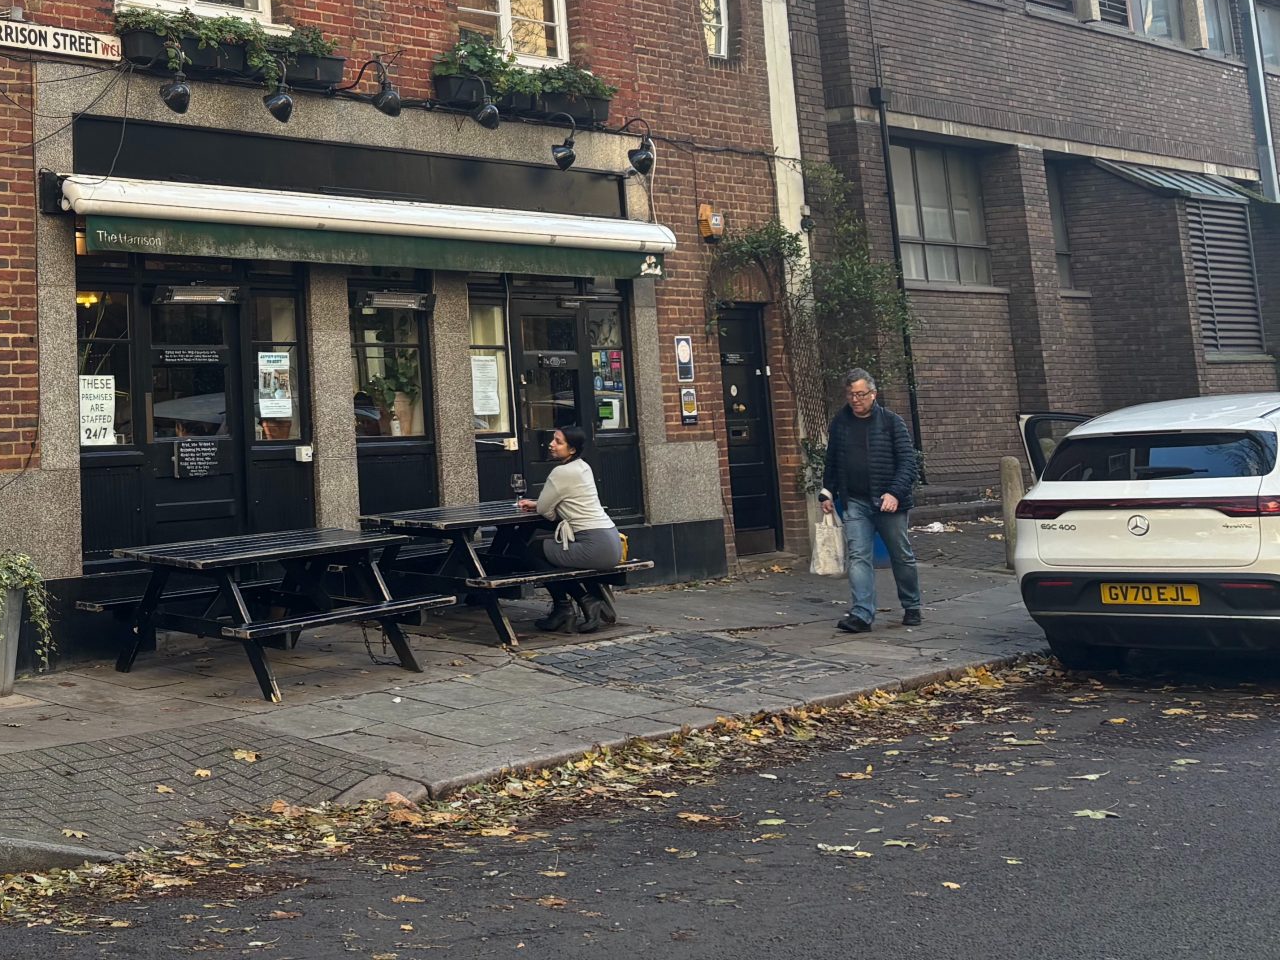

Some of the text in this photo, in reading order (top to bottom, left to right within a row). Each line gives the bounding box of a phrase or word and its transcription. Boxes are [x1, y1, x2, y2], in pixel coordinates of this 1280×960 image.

[53, 31, 100, 55] STREET
[96, 230, 162, 246] The Harrison
[81, 378, 112, 390] THESE
[81, 393, 113, 401] PREMISES
[90, 403, 105, 412] ARE
[81, 415, 113, 424] STAFFED
[85, 426, 108, 440] 24/7
[1108, 585, 1193, 602] GV70 EJL
